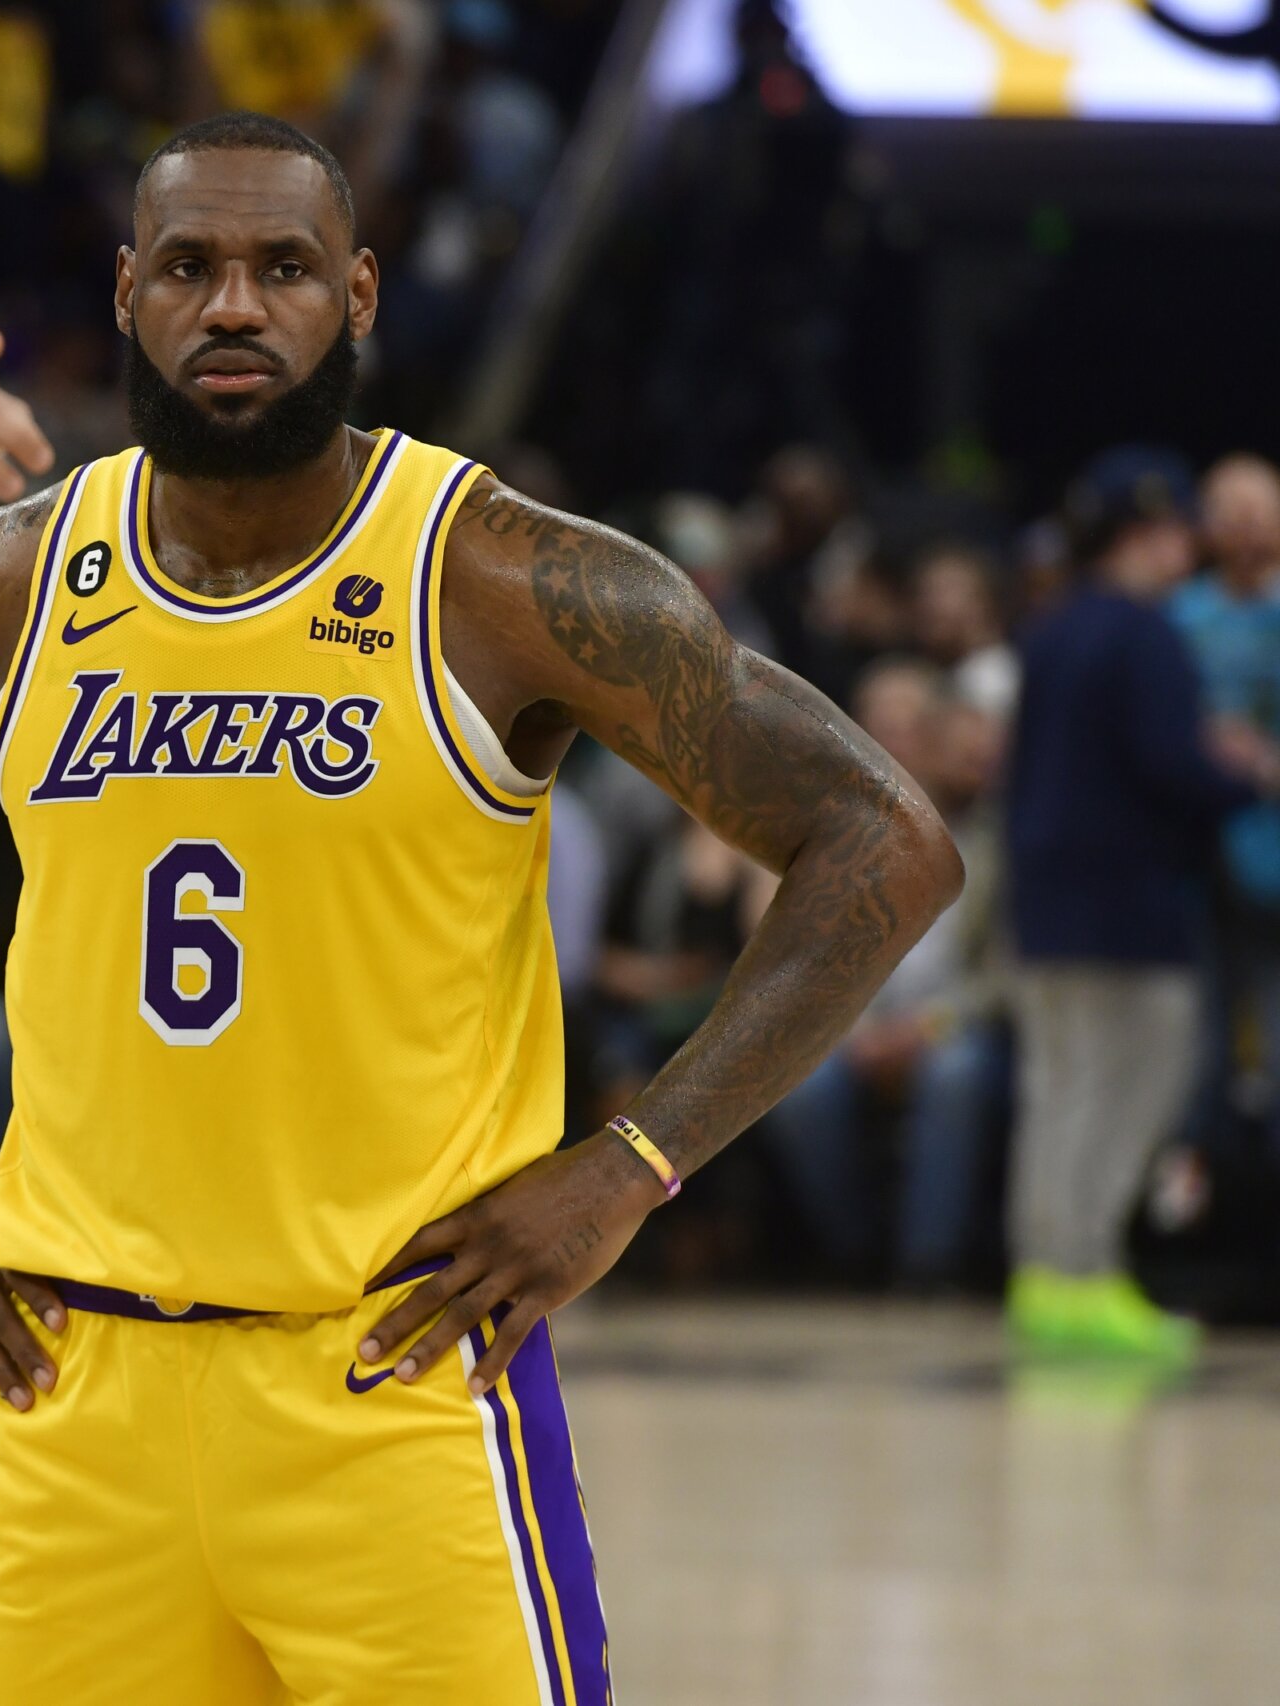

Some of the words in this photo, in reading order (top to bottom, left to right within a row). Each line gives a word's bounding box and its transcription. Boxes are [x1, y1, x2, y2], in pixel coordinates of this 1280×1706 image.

[77, 548, 103, 590] 6
[309, 615, 395, 655] bibigo
[26, 669, 384, 805] LAKERS
[138, 838, 246, 1047] 6
